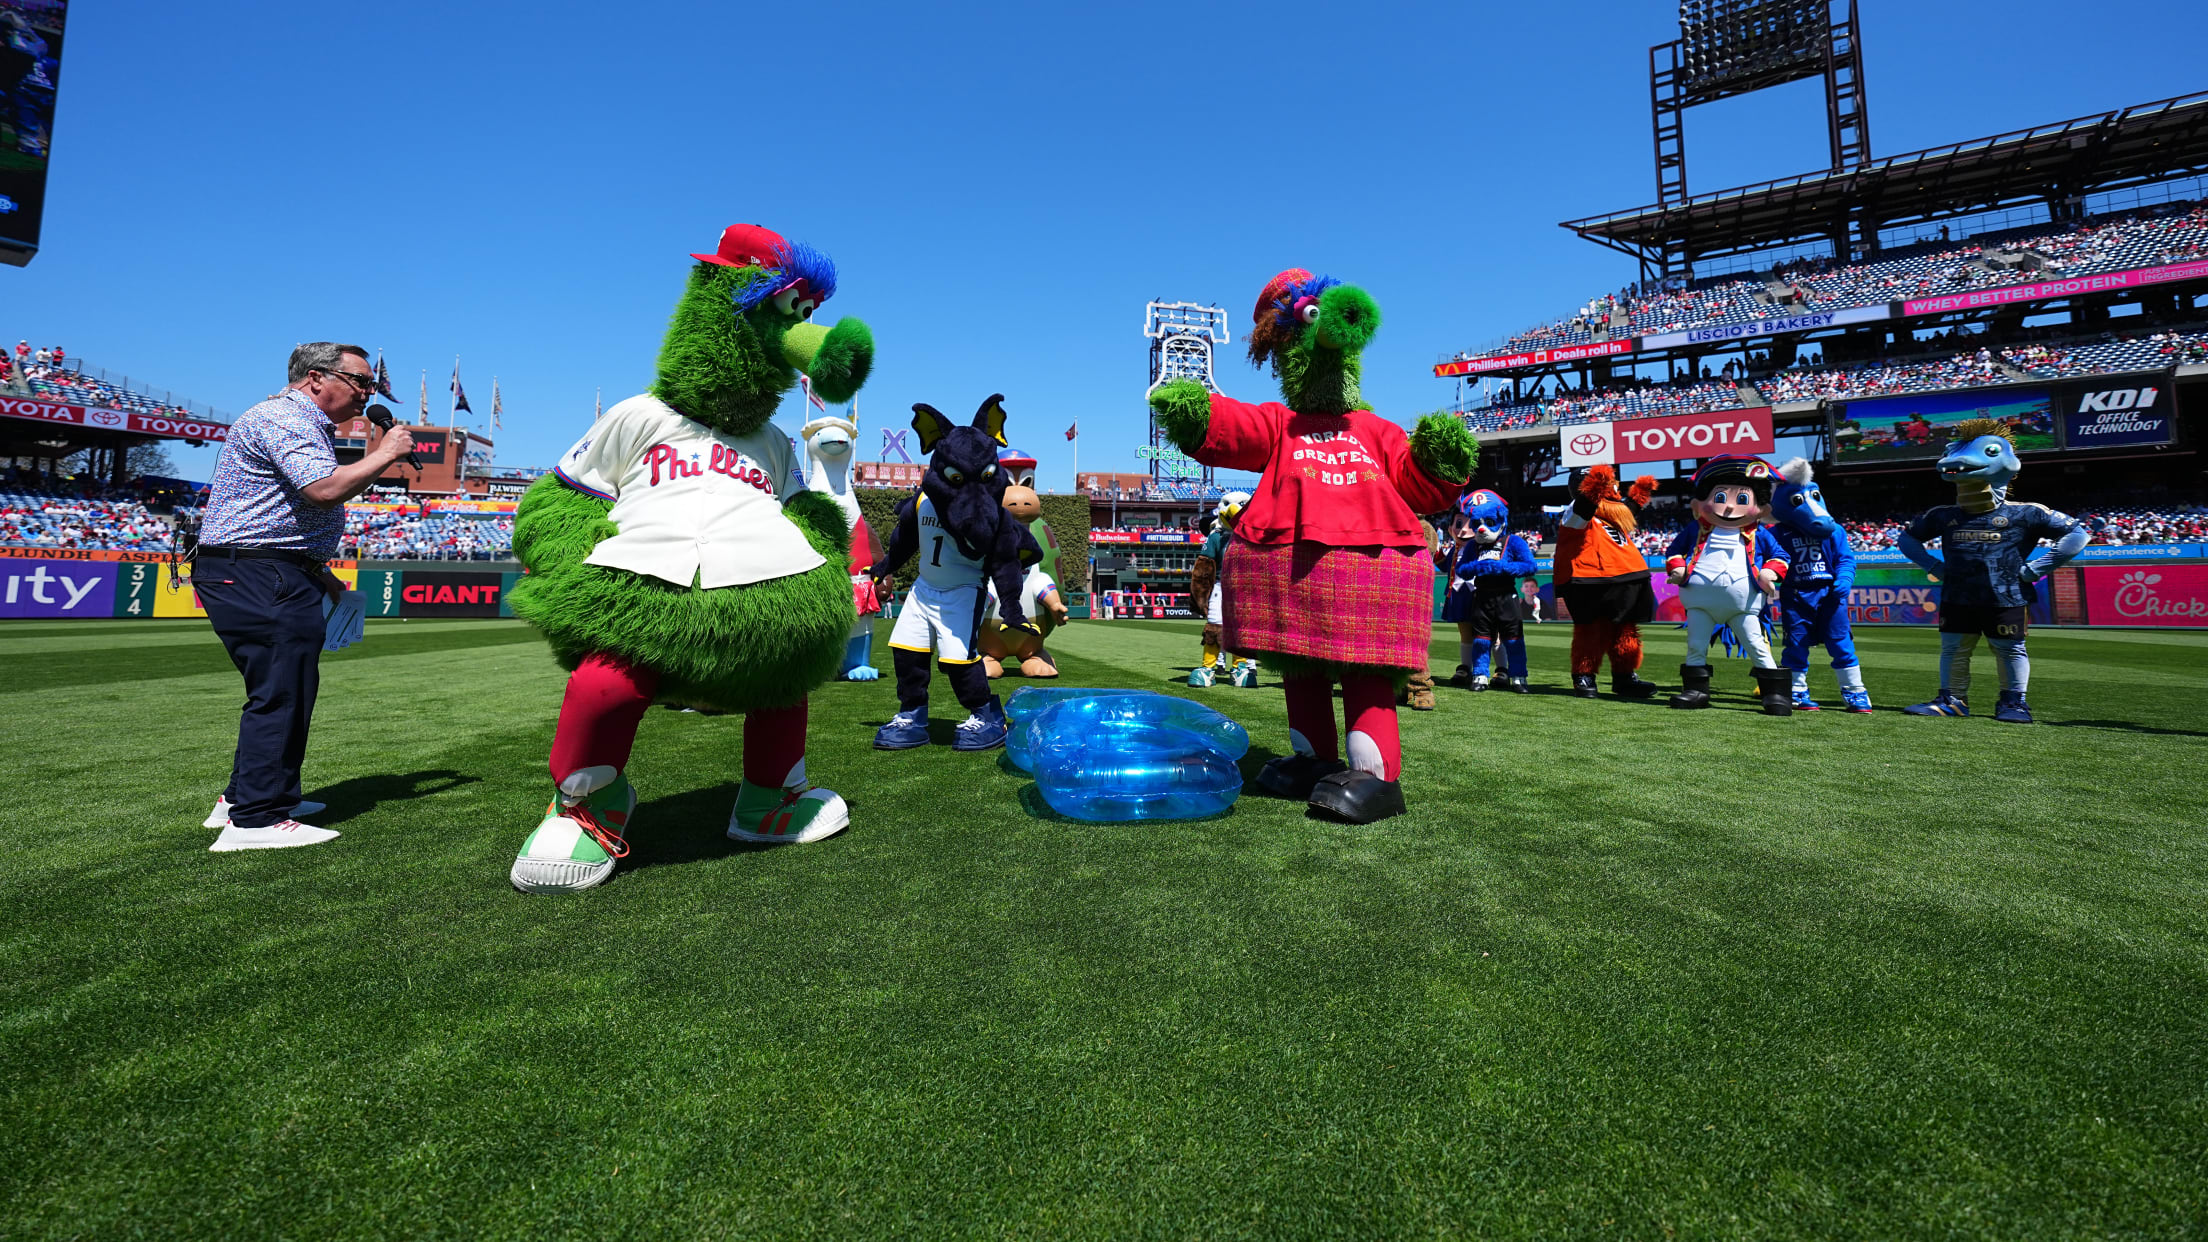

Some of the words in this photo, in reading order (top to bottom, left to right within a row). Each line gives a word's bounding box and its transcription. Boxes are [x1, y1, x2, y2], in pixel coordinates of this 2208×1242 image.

[1911, 297, 1968, 313] WHEY
[1969, 286, 2037, 306] BETTER
[2041, 274, 2127, 296] PROTEIN
[1688, 323, 1758, 343] LISCIO'S
[1764, 313, 1834, 332] BAKERY
[1467, 356, 1507, 372] Phillies
[1508, 355, 1529, 366] win
[1553, 347, 1587, 360] Deals
[1588, 344, 1608, 356] roll
[1609, 342, 1623, 353] in
[2078, 387, 2158, 413] KDI
[2096, 411, 2141, 424] OFFICE
[138, 417, 227, 438] TOYOTA
[2078, 419, 2162, 435] TECHNOLOGY
[1621, 420, 1760, 451] TOYOTA
[643, 443, 773, 495] Phillies
[1171, 463, 1201, 477] Park
[1321, 470, 1357, 485] MOM
[373, 484, 406, 493] Fanatics
[1095, 533, 1131, 541] Budweiser
[1792, 537, 1820, 547] BLUE
[1952, 531, 2002, 541] BIMBO
[931, 535, 944, 567] 1
[1795, 546, 1822, 562] 76
[2084, 547, 2165, 557] Independence
[1795, 561, 1826, 574] COATS
[6, 566, 102, 610] ity
[402, 585, 500, 604] GIANT
[1997, 624, 2019, 636] 00
